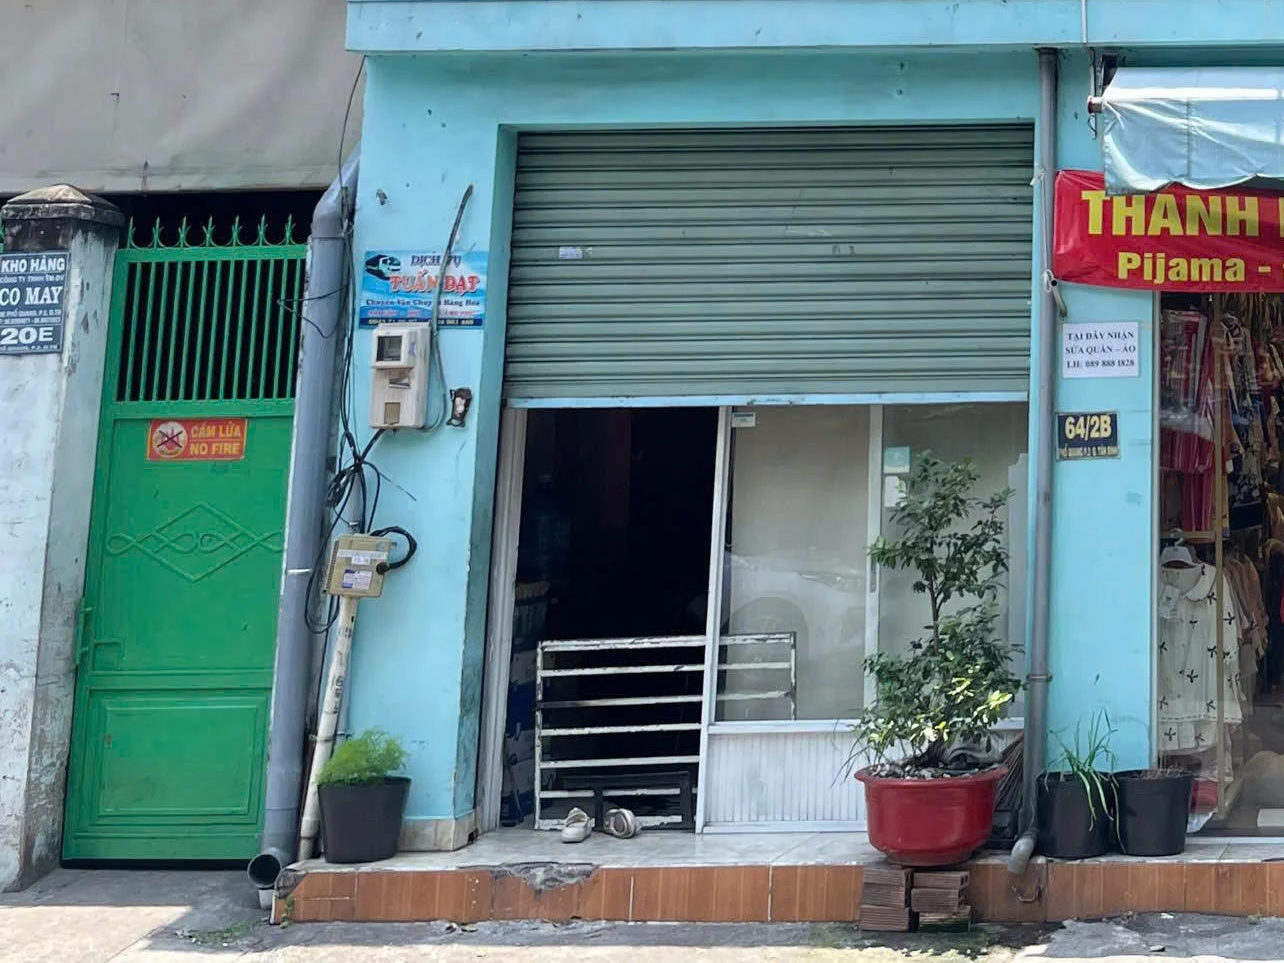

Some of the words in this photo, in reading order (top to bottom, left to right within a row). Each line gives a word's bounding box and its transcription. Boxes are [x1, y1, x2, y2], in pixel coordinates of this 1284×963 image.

[1081, 190, 1260, 236] THANH
[1, 259, 27, 273] KHO
[30, 255, 66, 272] HÀNG
[1118, 251, 1246, 284] Pijama
[25, 286, 63, 305] MAY
[443, 275, 480, 296] ĐẠT
[0, 327, 54, 345] 20E
[1065, 415, 1112, 441] 64/2B
[190, 443, 208, 455] NO
[212, 442, 239, 455] FIRE
